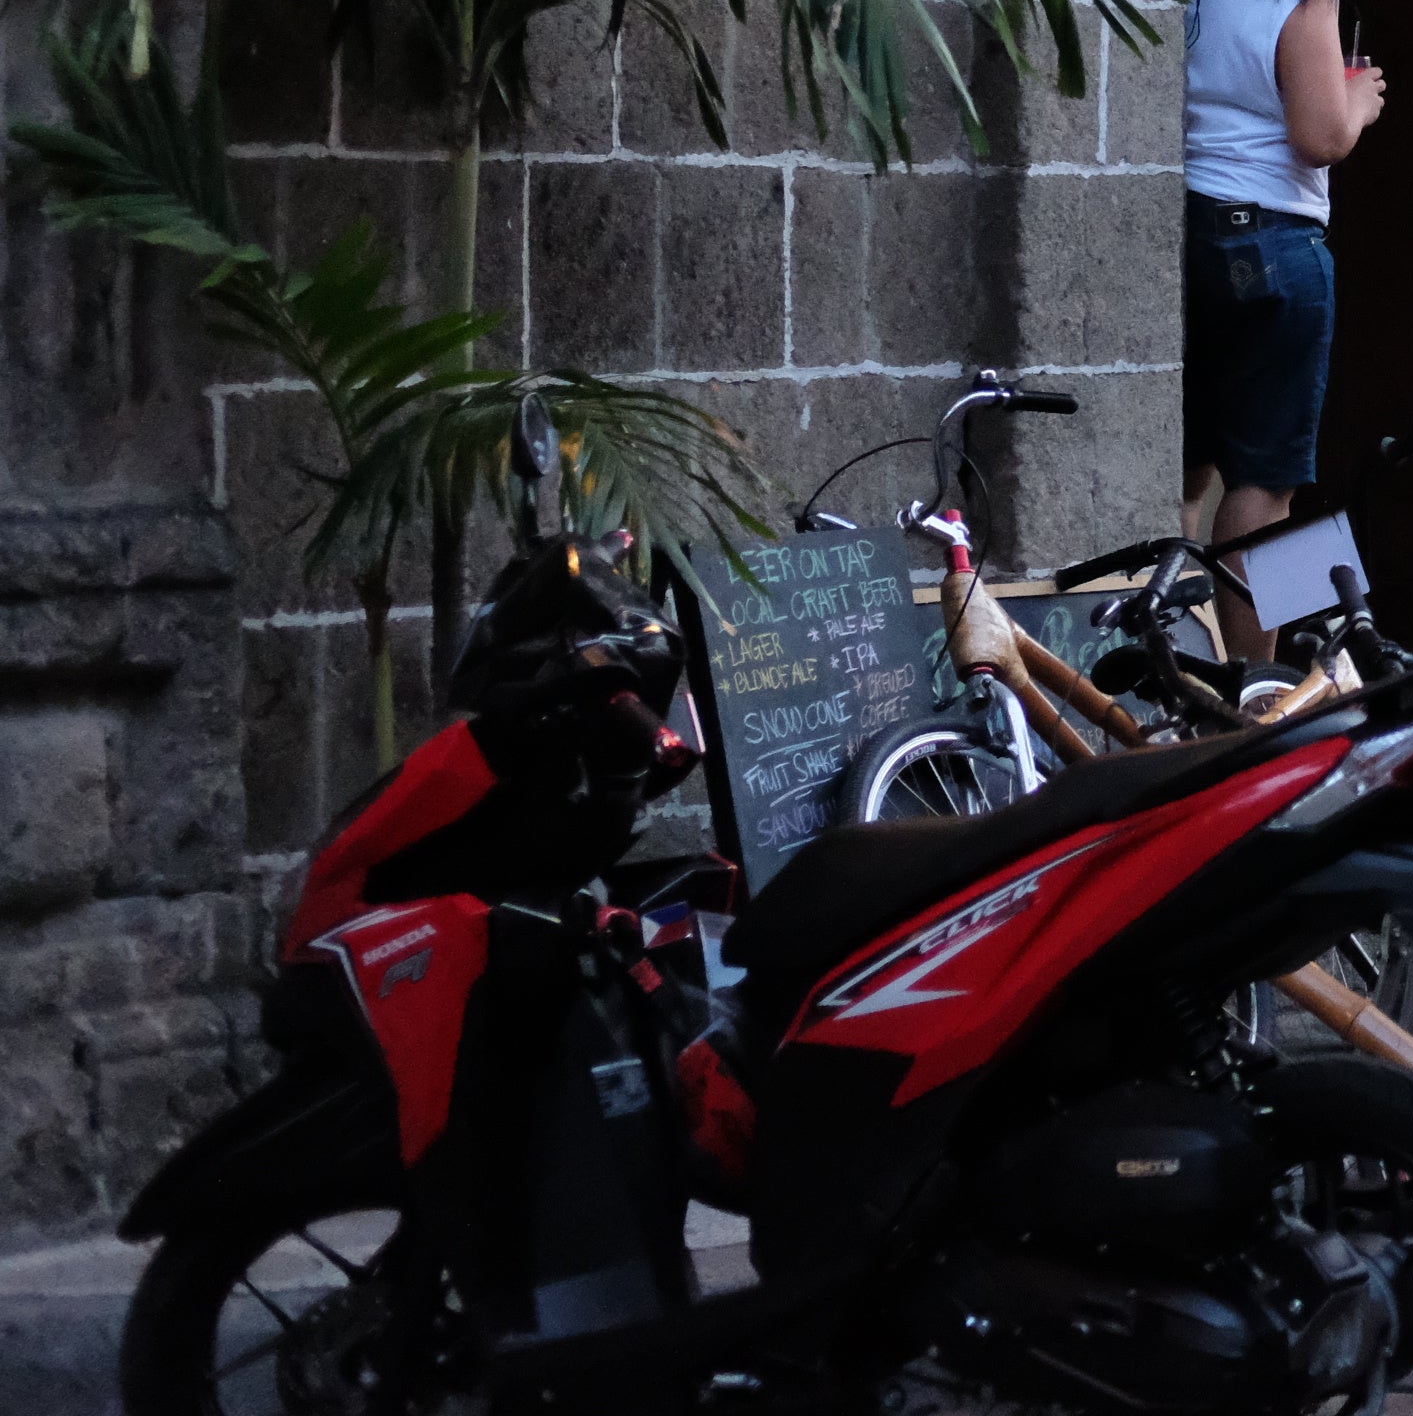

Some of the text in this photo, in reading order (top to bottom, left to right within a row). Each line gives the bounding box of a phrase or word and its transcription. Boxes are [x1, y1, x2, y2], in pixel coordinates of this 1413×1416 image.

[800, 548, 829, 579] ON
[829, 539, 875, 579] TAP
[790, 583, 850, 621] CRAFT
[858, 576, 903, 614] BEER
[823, 611, 886, 641] PALE ALE
[728, 632, 784, 667] LAGER
[841, 642, 880, 674] IPA
[733, 658, 818, 694] BLONDE ALE
[867, 663, 916, 701] BREWED
[743, 689, 853, 744] SNOW CONE
[860, 695, 911, 729] COFFEE
[742, 744, 844, 799] FRUIT SHAKE
[919, 875, 1040, 955] CLICK
